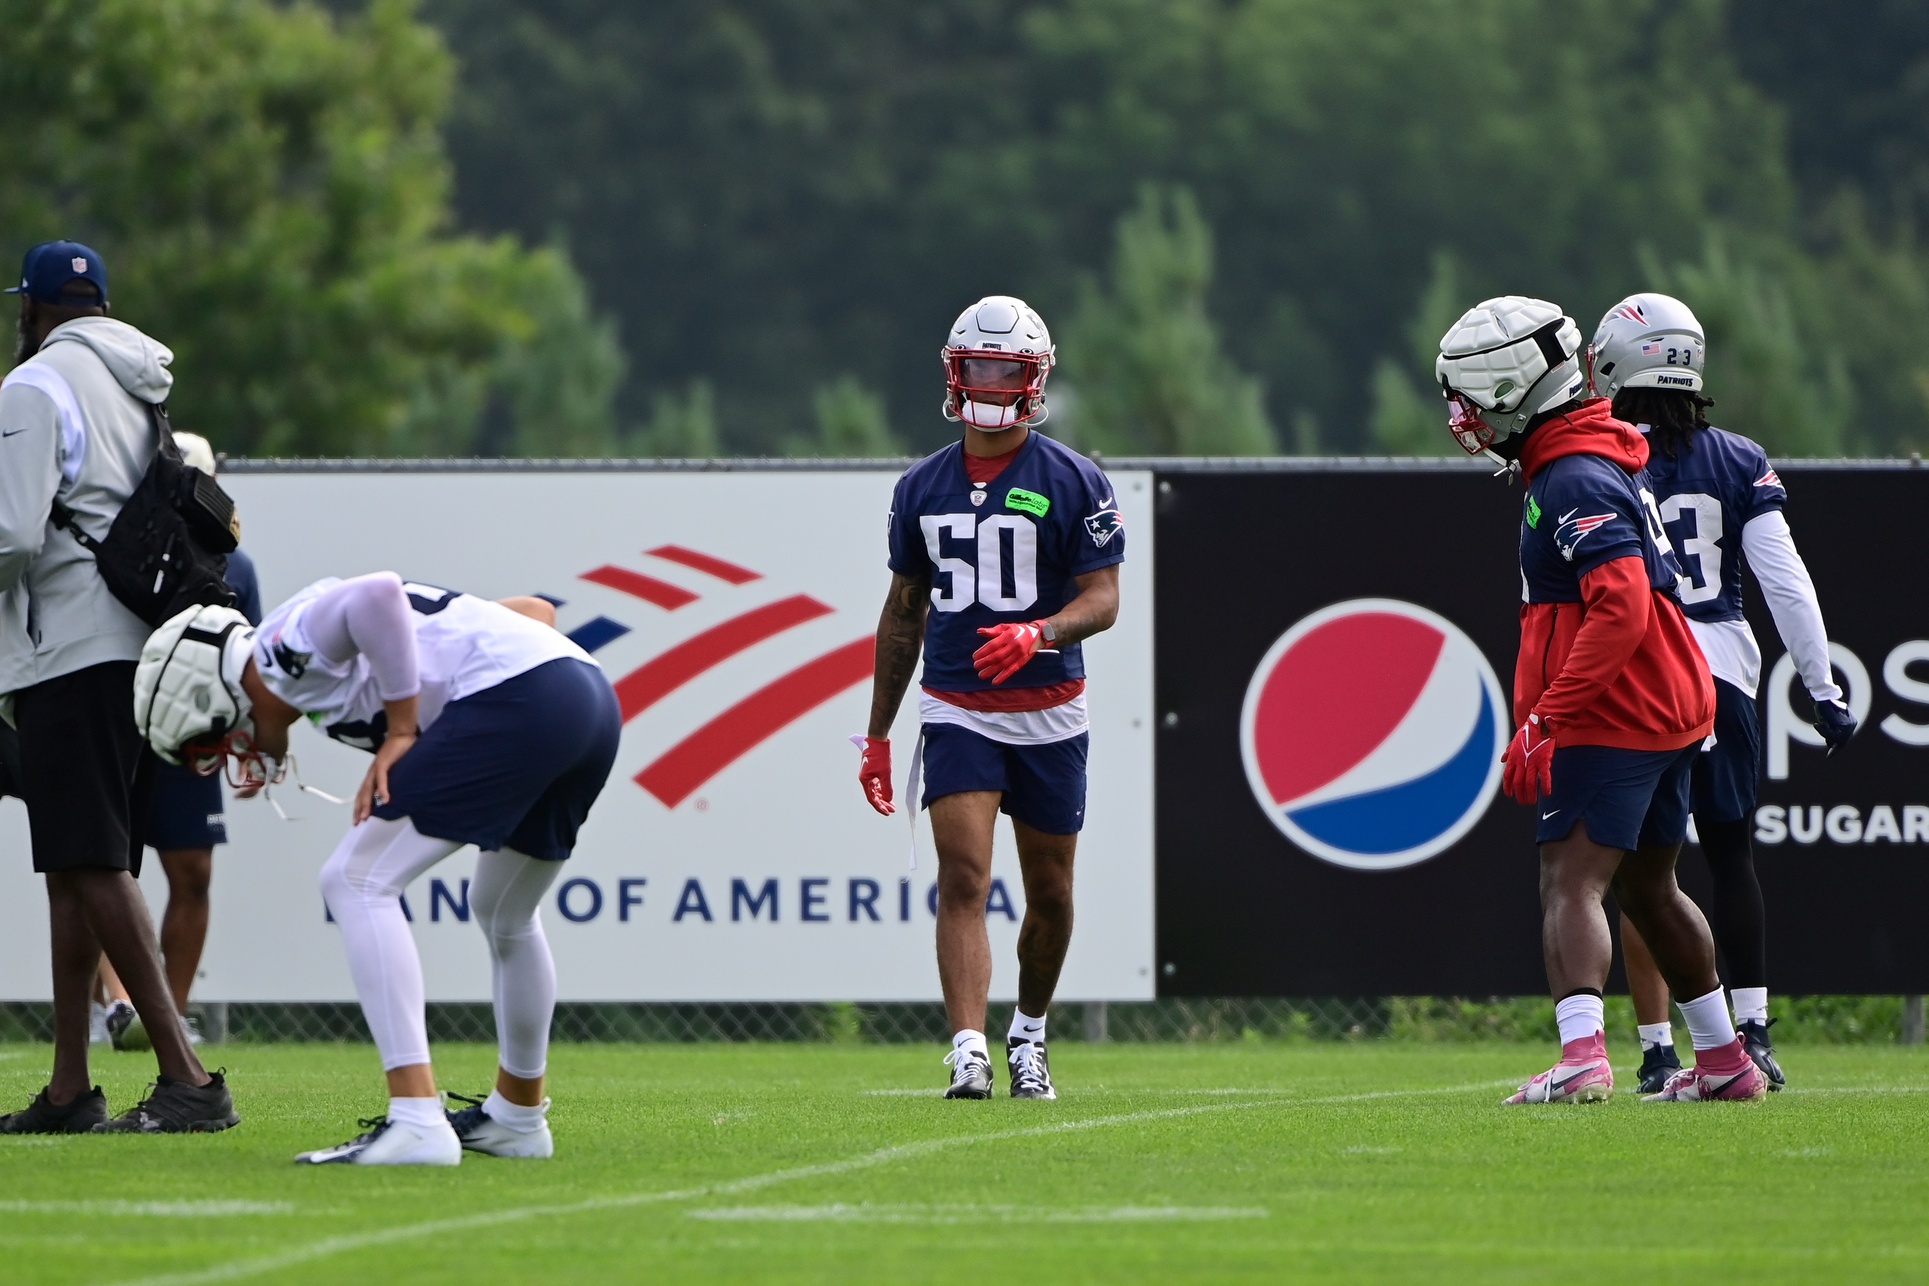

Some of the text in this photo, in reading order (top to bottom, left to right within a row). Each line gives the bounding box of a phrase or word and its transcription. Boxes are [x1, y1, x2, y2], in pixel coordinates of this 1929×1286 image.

[1657, 375, 1693, 387] PATRIOTS
[919, 513, 1038, 612] 50
[1659, 493, 1723, 605] 3
[1755, 804, 1929, 844] SUGAR
[557, 877, 1019, 923] OF AMERIA
